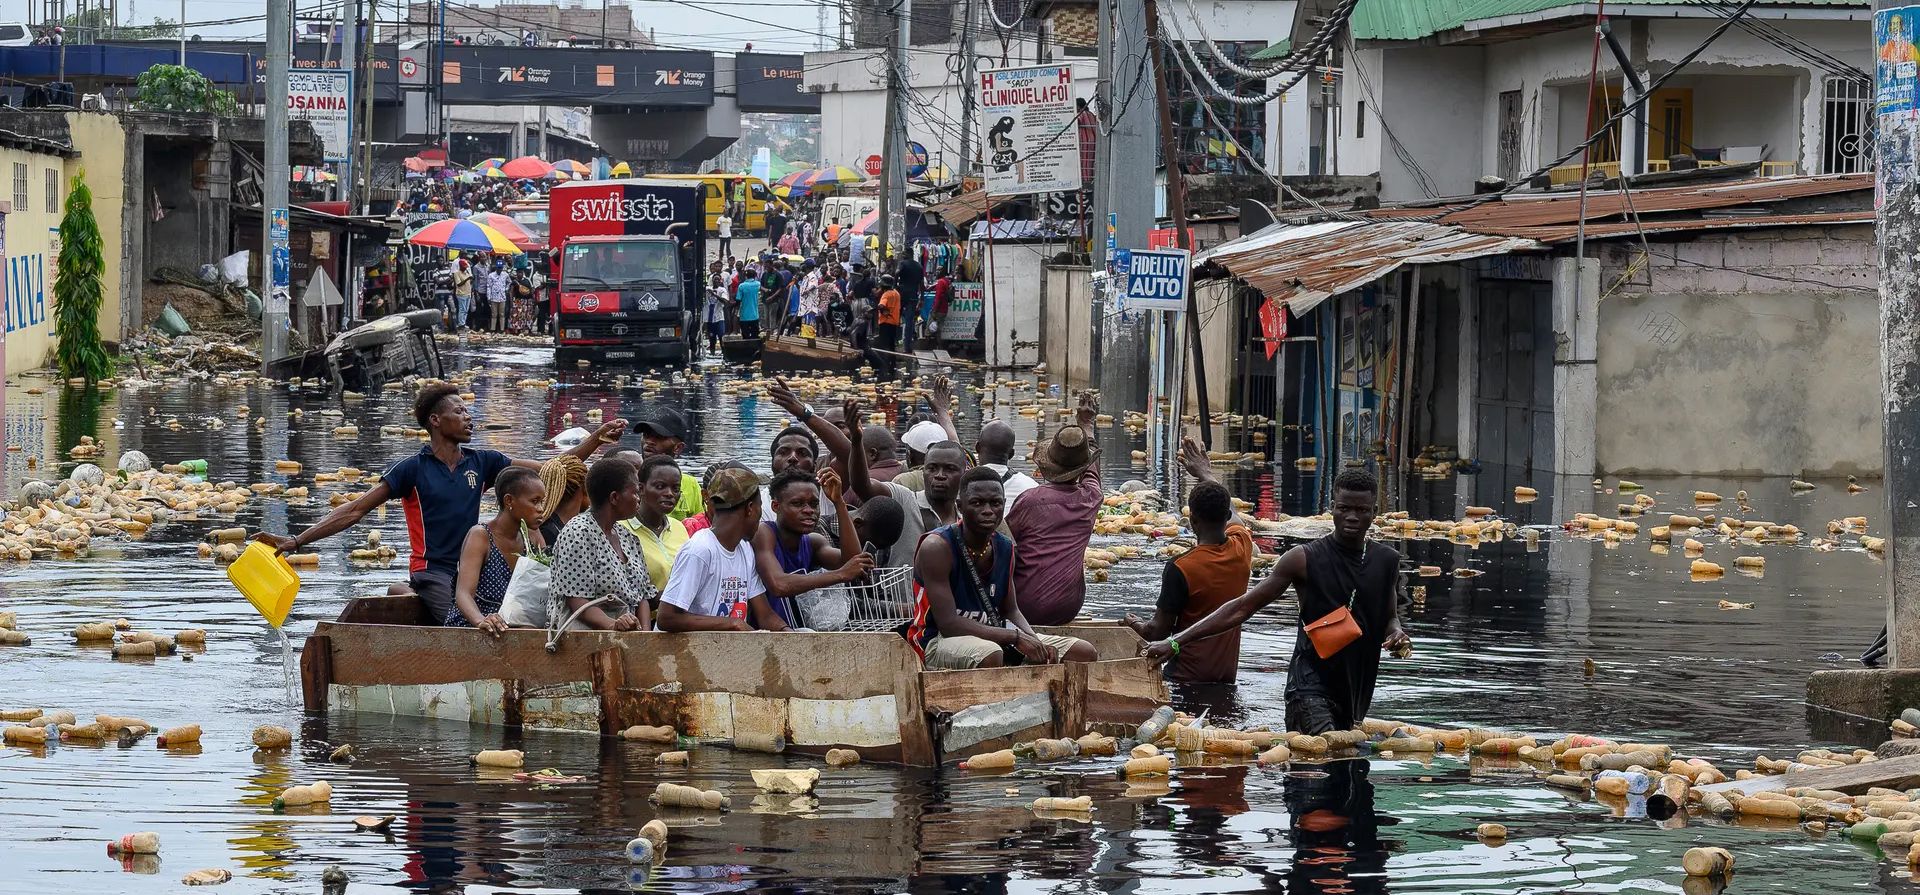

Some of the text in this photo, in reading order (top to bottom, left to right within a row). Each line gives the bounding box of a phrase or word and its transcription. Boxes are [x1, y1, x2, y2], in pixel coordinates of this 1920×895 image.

[528, 68, 551, 76] Orange
[683, 71, 706, 79] Orange
[763, 67, 804, 79] Le num
[1011, 70, 1028, 79] SALUT
[1029, 69, 1038, 77] DU
[1058, 68, 1071, 84] H
[288, 75, 334, 83] COMPLEXE
[528, 75, 549, 83] Money
[683, 78, 704, 86] Money
[981, 74, 994, 90] H
[796, 84, 804, 93] S
[982, 85, 1069, 107] CLINIQUE LA FOI
[288, 95, 347, 110] OSANNA
[865, 162, 882, 170] STO
[571, 192, 674, 221] swissta
[1130, 255, 1185, 276] FIDELITY
[1130, 278, 1181, 297] AUTO
[954, 289, 983, 299] CLINI
[952, 300, 981, 312] HAR
